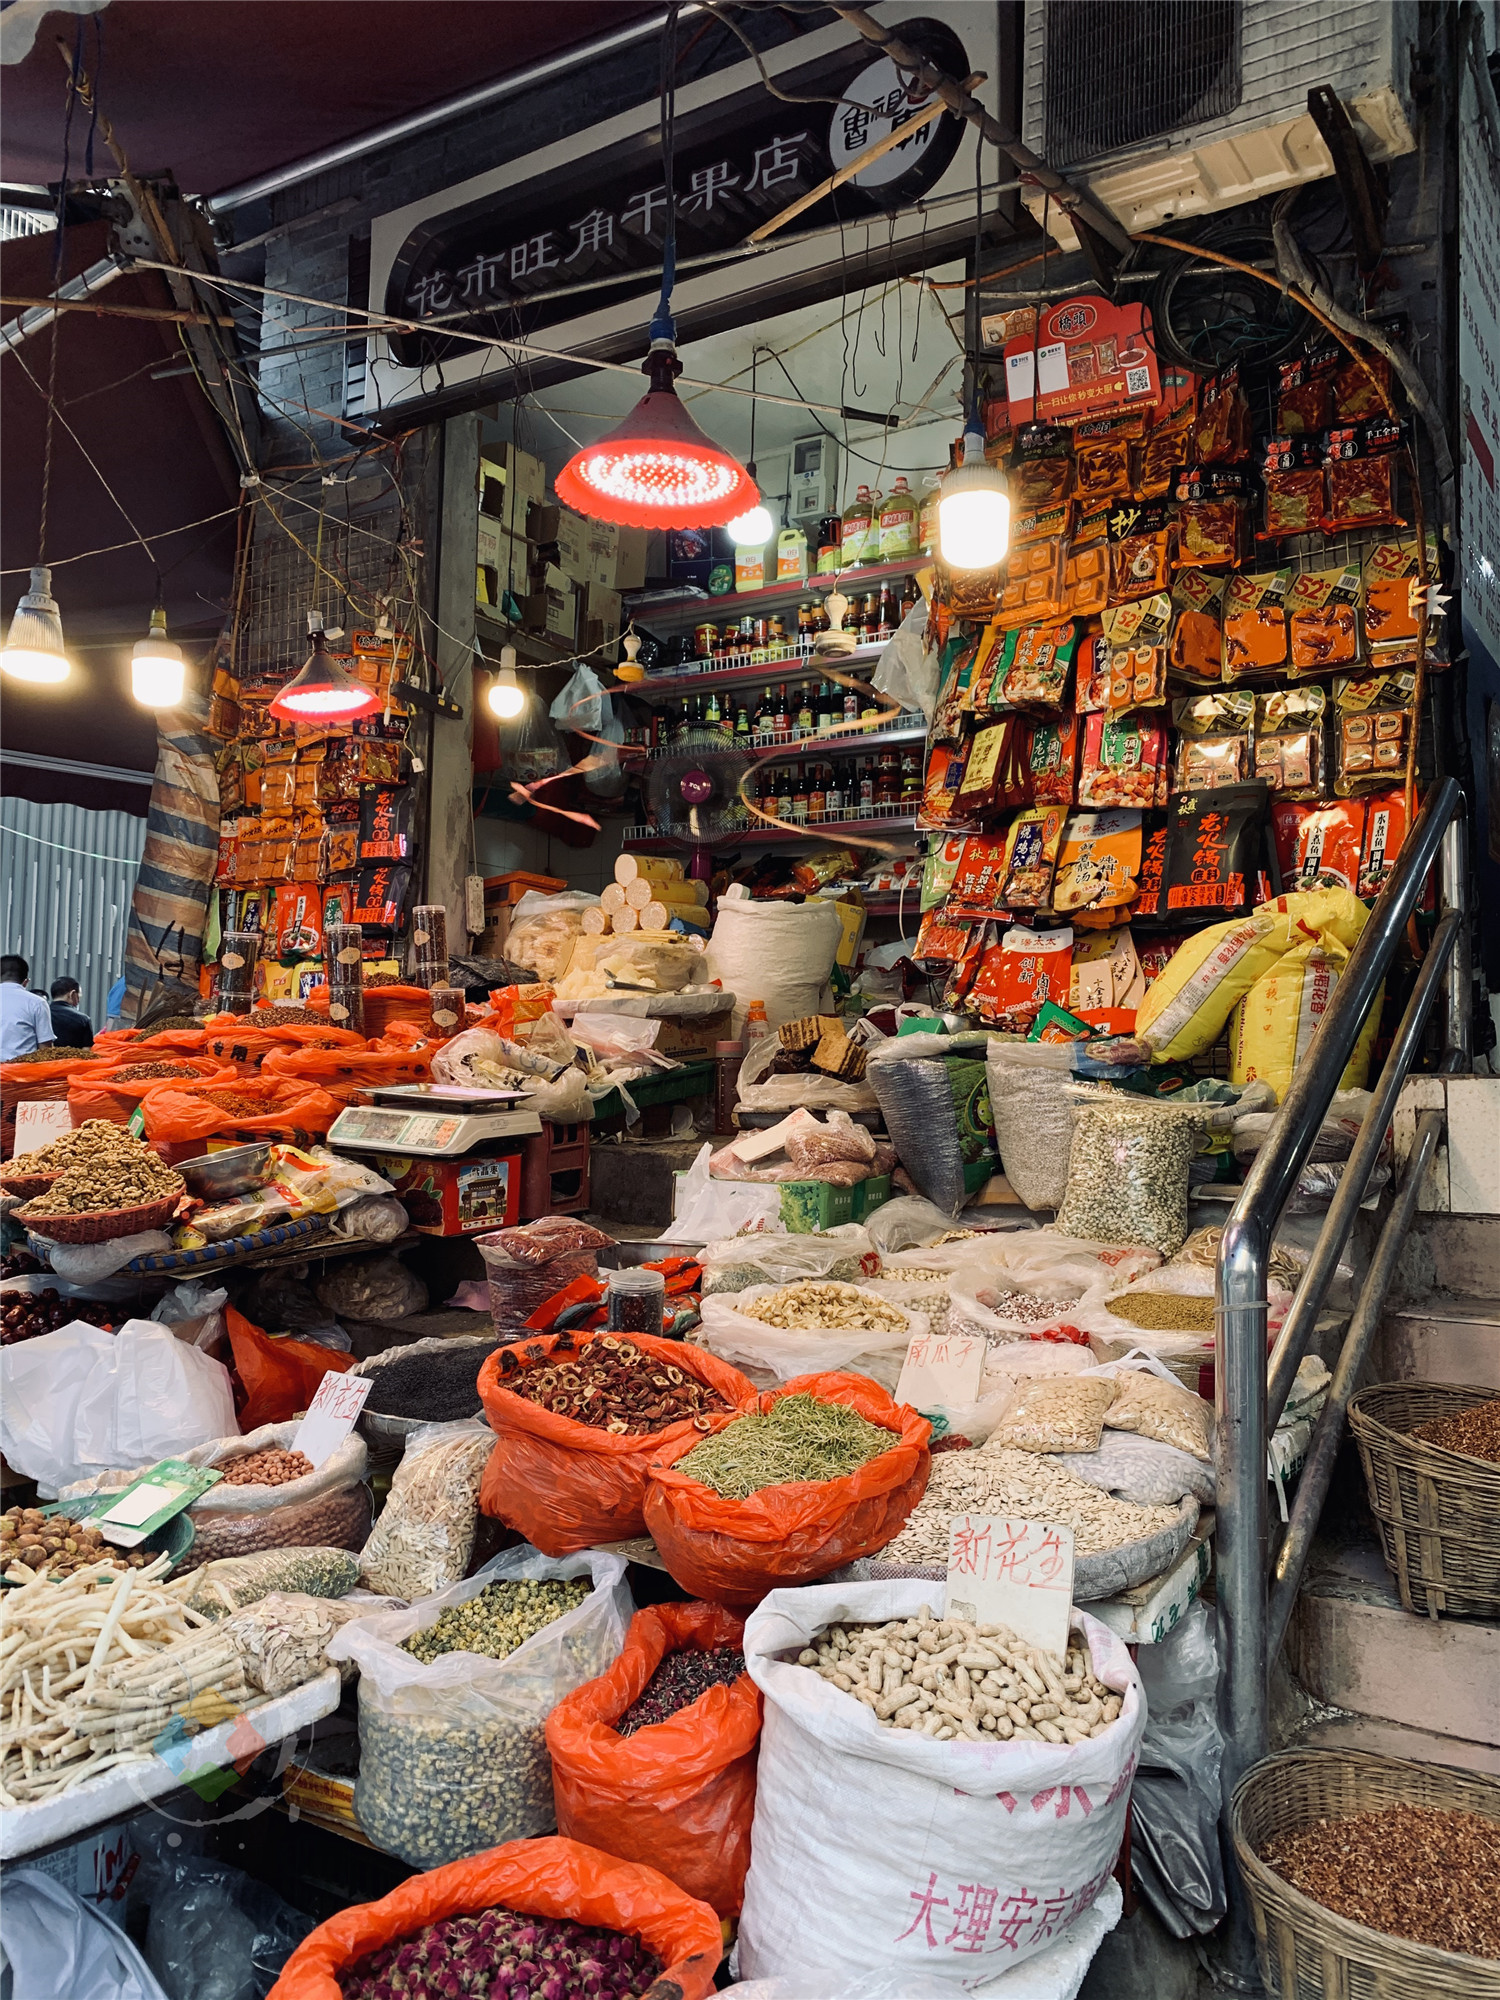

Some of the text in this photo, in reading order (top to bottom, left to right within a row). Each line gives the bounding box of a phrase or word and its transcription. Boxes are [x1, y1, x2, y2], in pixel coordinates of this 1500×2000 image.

[407, 132, 808, 317] 花市旺角干果店
[1031, 728, 1048, 769] 小龙虾
[1192, 811, 1230, 867] 老火锅
[1374, 813, 1386, 848] 水煮鱼
[1190, 867, 1221, 885] 底料
[1017, 956, 1036, 985] 创新
[907, 1335, 977, 1368] 南瓜子
[311, 1373, 367, 1421] 新花生
[949, 1516, 1072, 1593] 新花生
